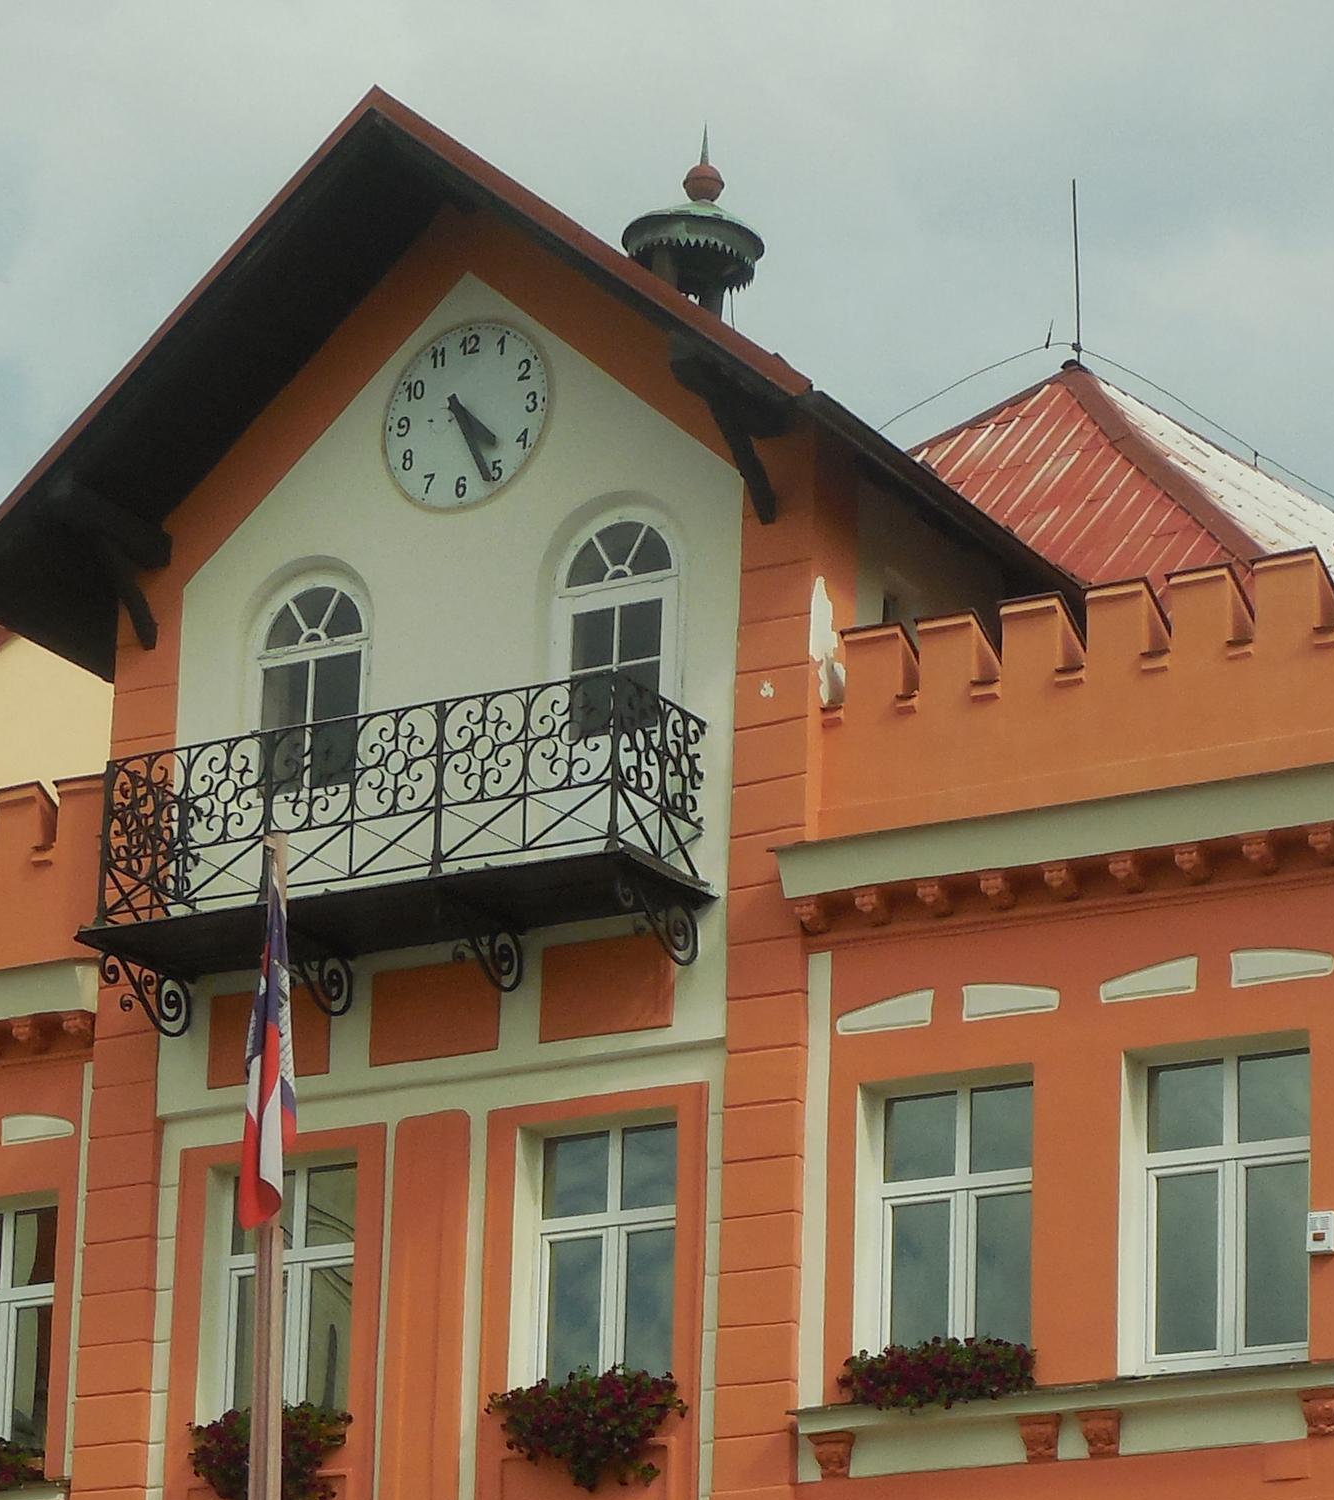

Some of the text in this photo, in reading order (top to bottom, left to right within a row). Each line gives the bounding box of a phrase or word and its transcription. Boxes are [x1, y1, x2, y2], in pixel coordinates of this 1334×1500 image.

[459, 333, 480, 355] 12
[497, 335, 506, 355] 1
[430, 346, 446, 368] 11
[517, 358, 531, 381] 2
[405, 379, 425, 401] 10
[525, 391, 538, 412] 3
[396, 416, 410, 437] 9
[515, 427, 529, 450] 4
[402, 448, 413, 471] 8
[491, 459, 503, 481] 5
[423, 473, 435, 494] 7
[455, 476, 467, 498] 6
